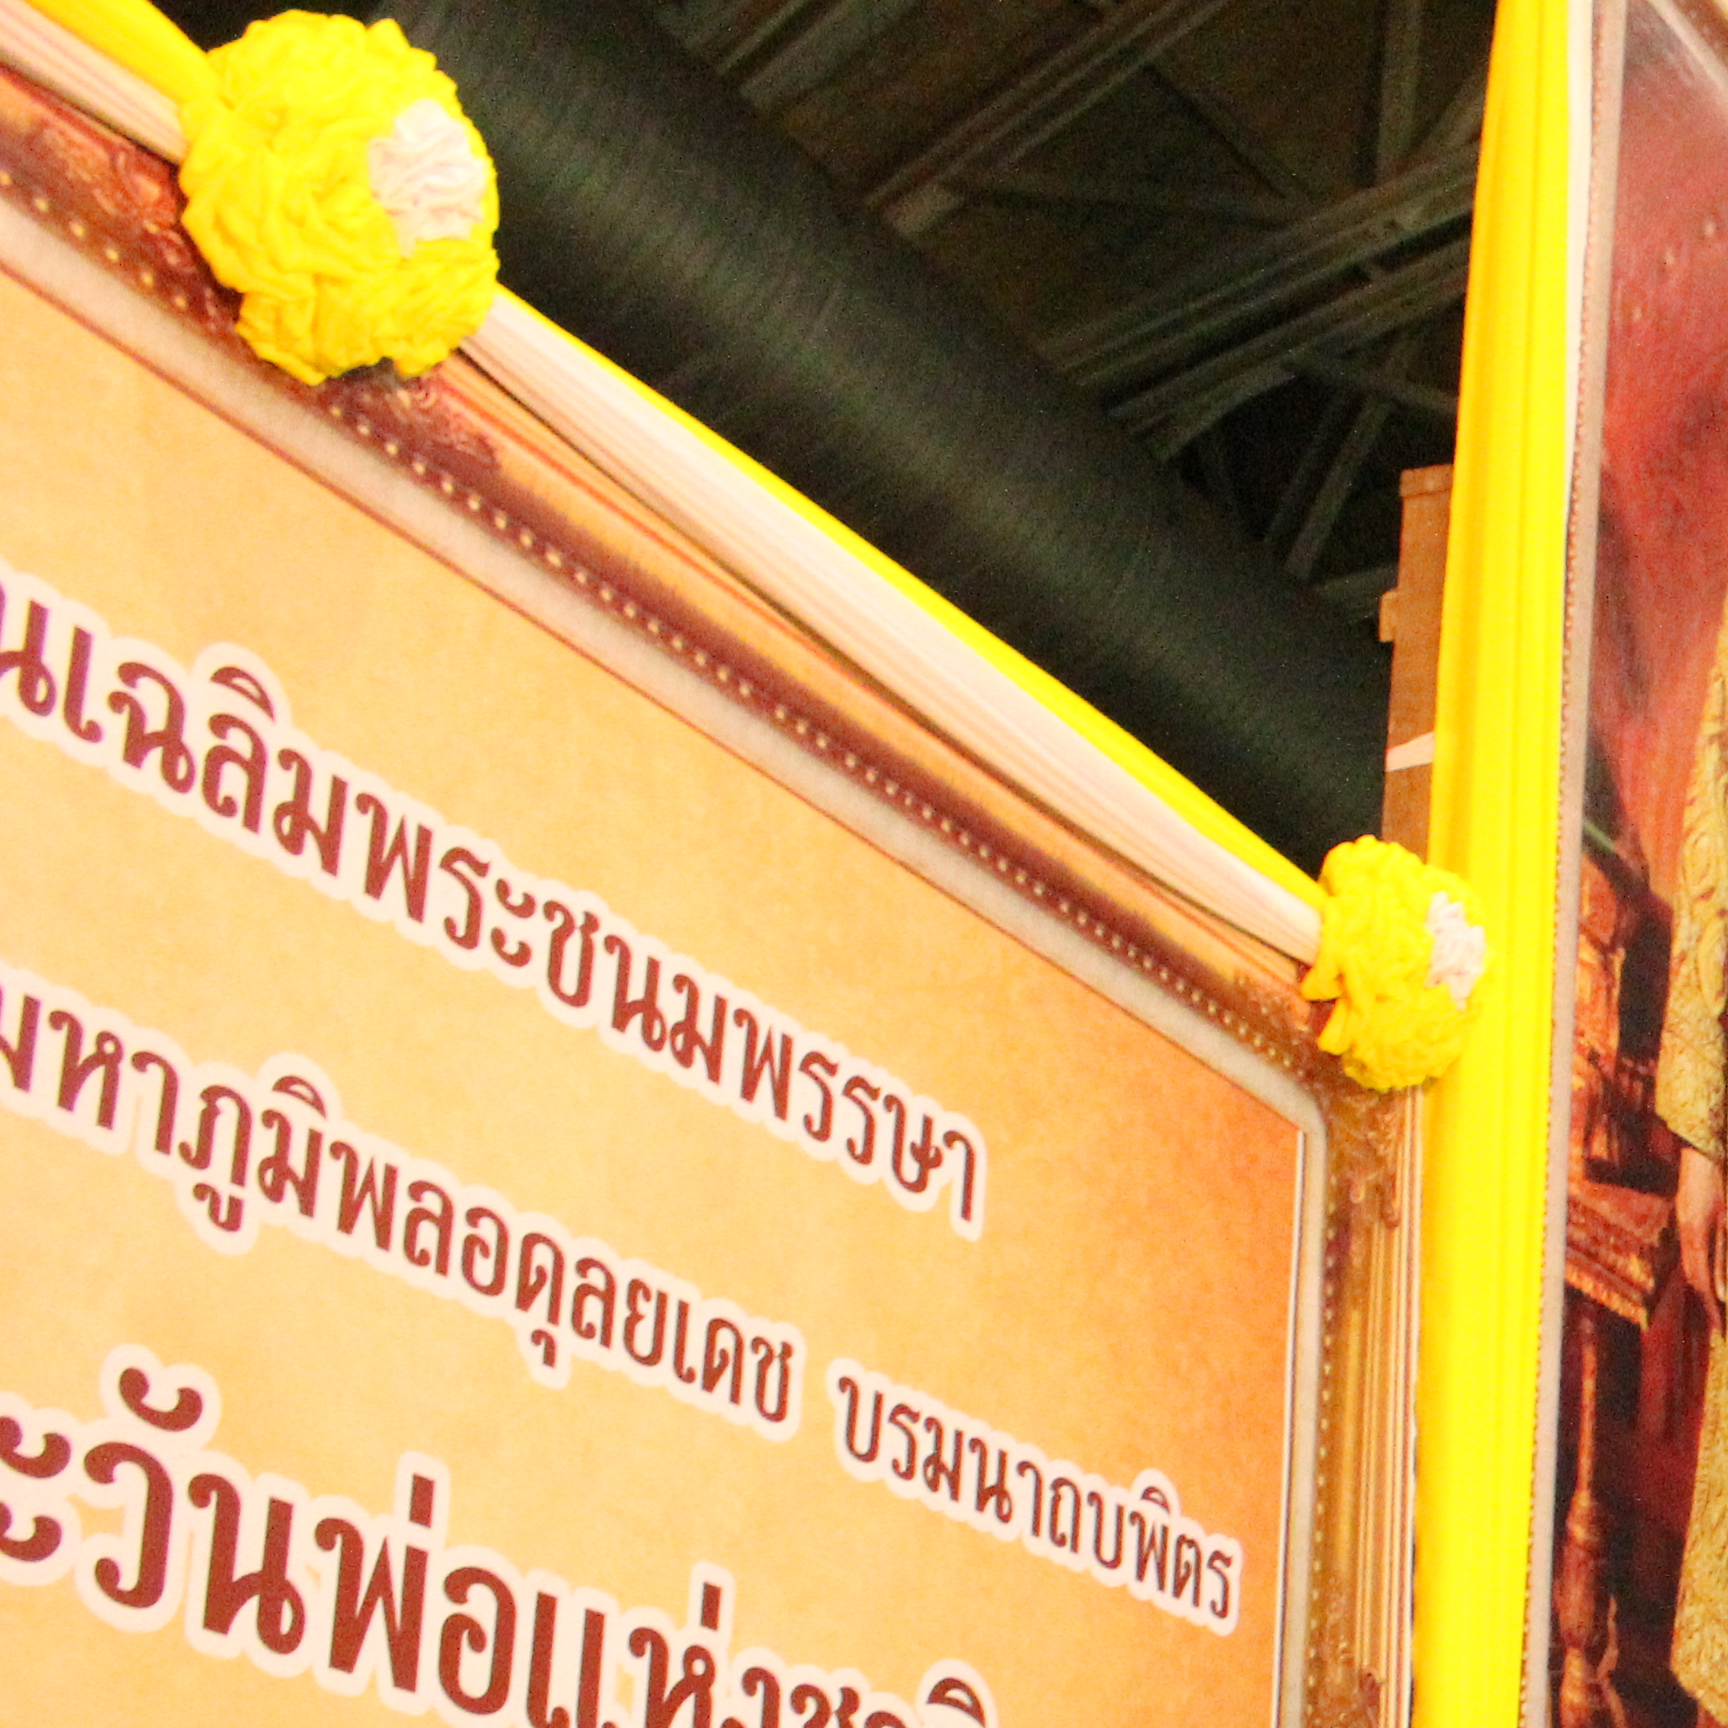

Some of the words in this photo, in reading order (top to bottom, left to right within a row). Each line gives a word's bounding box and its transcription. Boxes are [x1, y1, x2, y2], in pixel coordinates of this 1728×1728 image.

[838, 1376, 1234, 1621] บรมนาถบพิตร
